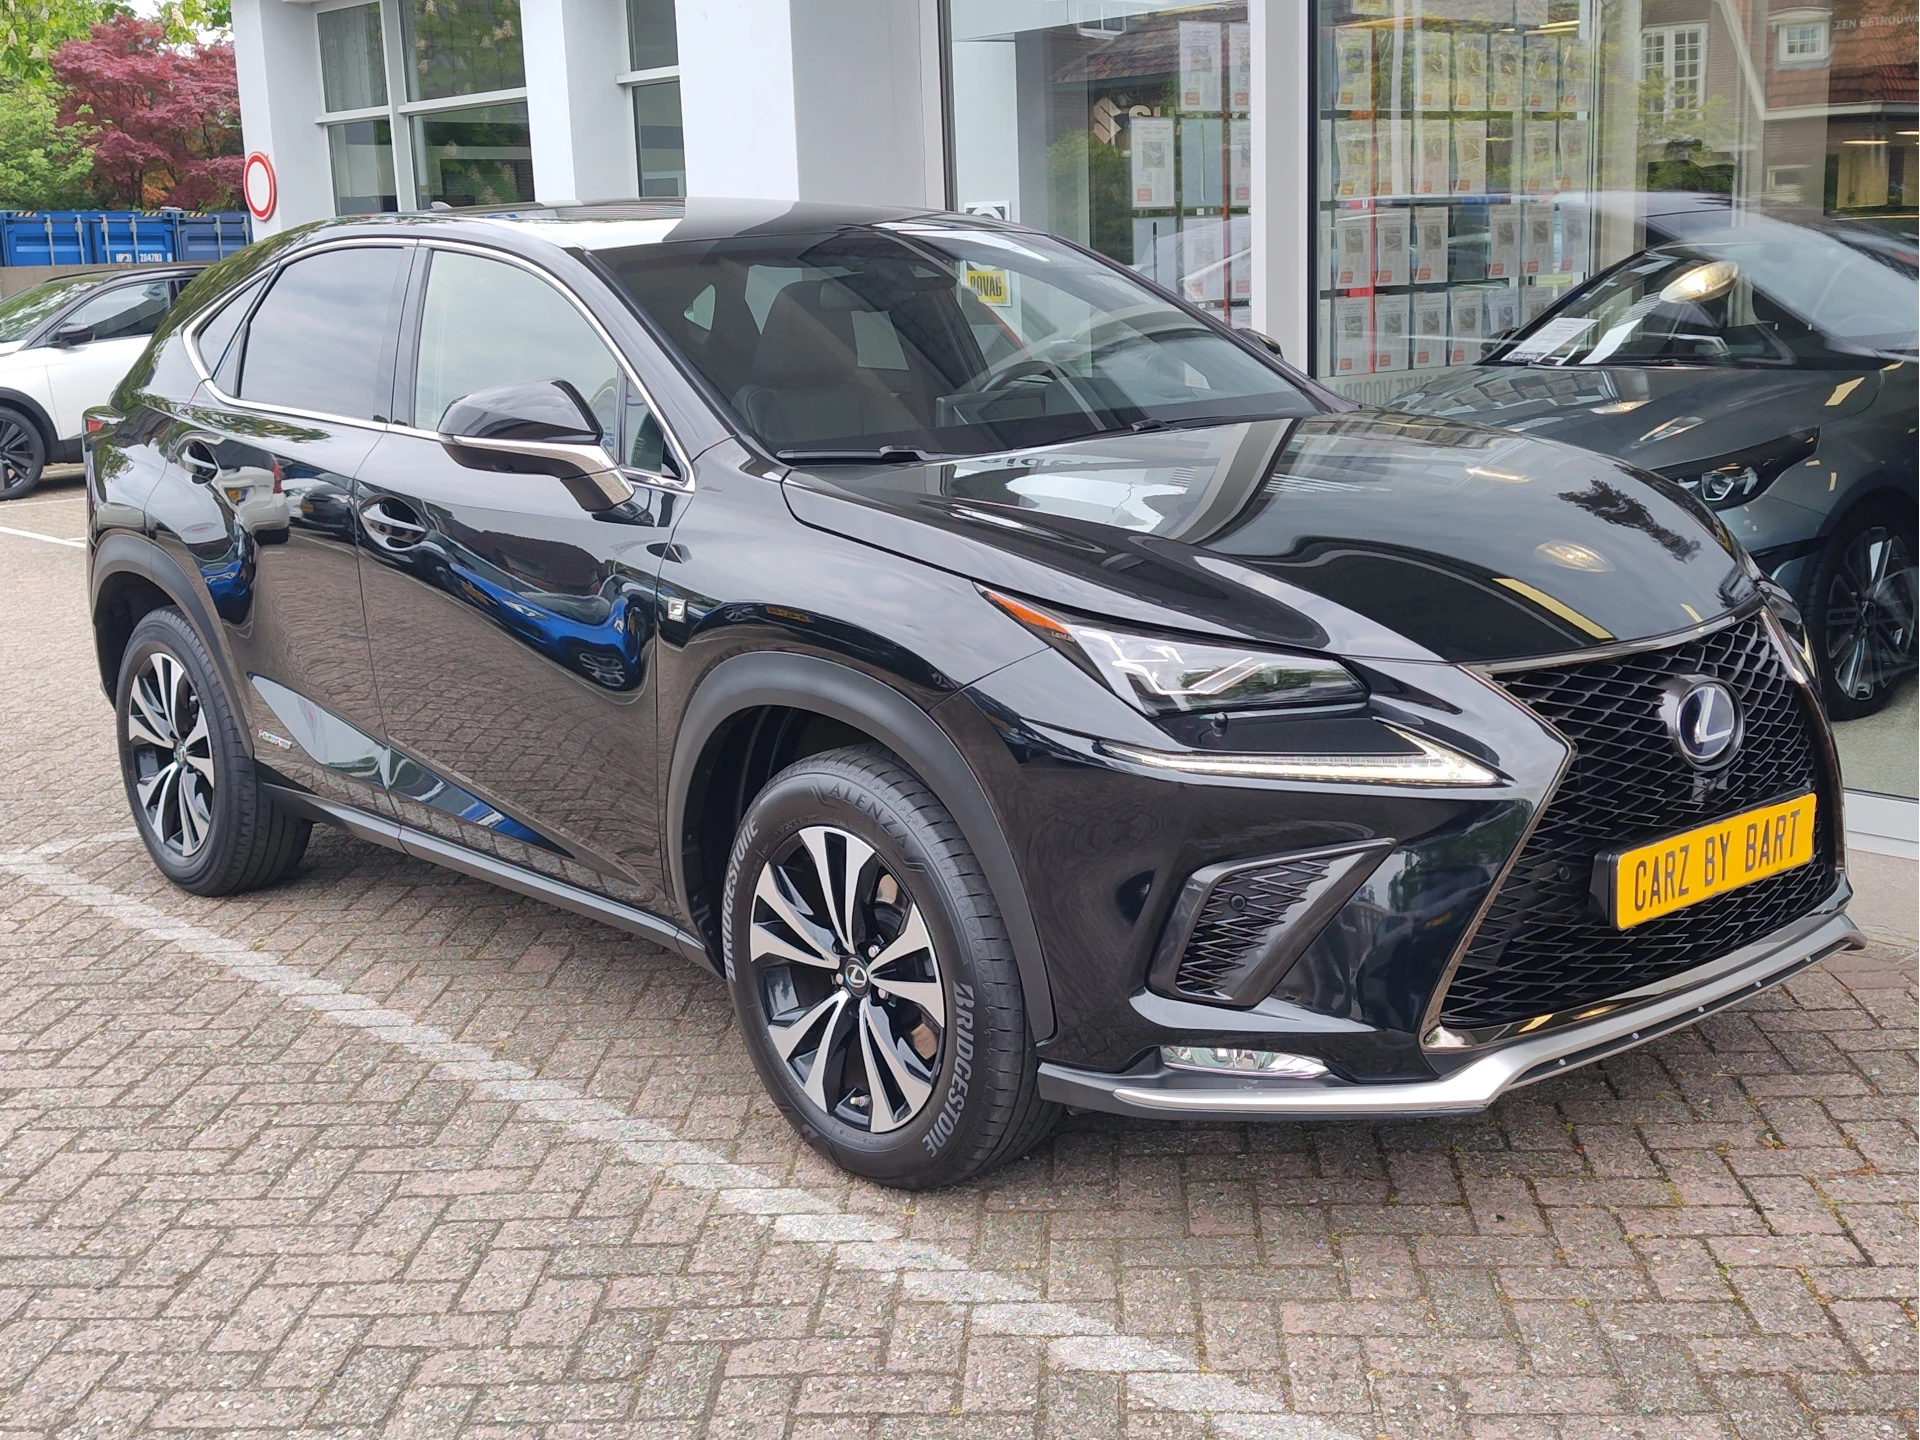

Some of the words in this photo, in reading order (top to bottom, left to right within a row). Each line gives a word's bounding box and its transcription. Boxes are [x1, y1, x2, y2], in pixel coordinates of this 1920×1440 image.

[828, 782, 910, 850] ALENZA
[1633, 844, 1690, 912] CARZ
[1704, 830, 1732, 888] BY
[1744, 808, 1801, 873] BART
[721, 819, 759, 983] BRIDGESTONE
[921, 980, 976, 1159] BRIDGESTONE
